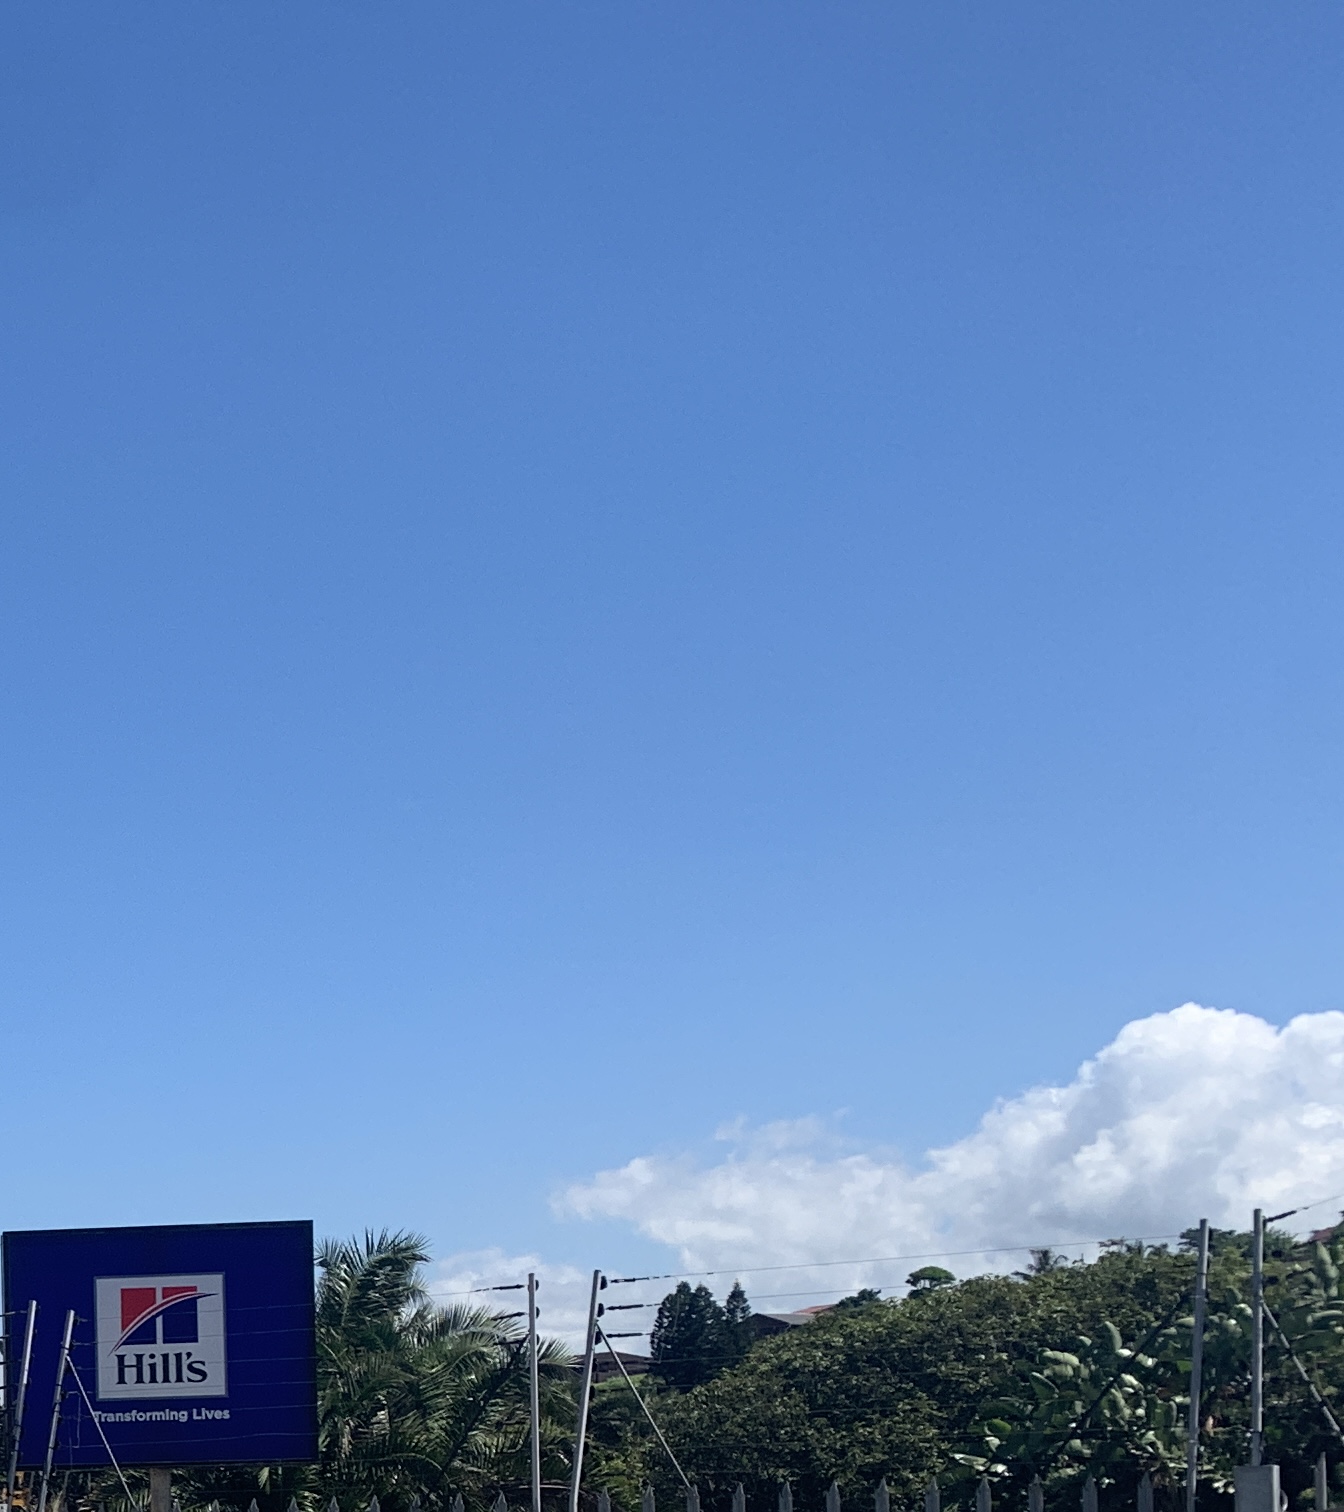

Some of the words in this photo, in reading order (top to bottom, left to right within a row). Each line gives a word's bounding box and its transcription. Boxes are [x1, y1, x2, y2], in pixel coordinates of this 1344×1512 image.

[115, 1351, 208, 1385] Hill's
[92, 1408, 188, 1423] Transforming
[193, 1407, 230, 1420] Lives
